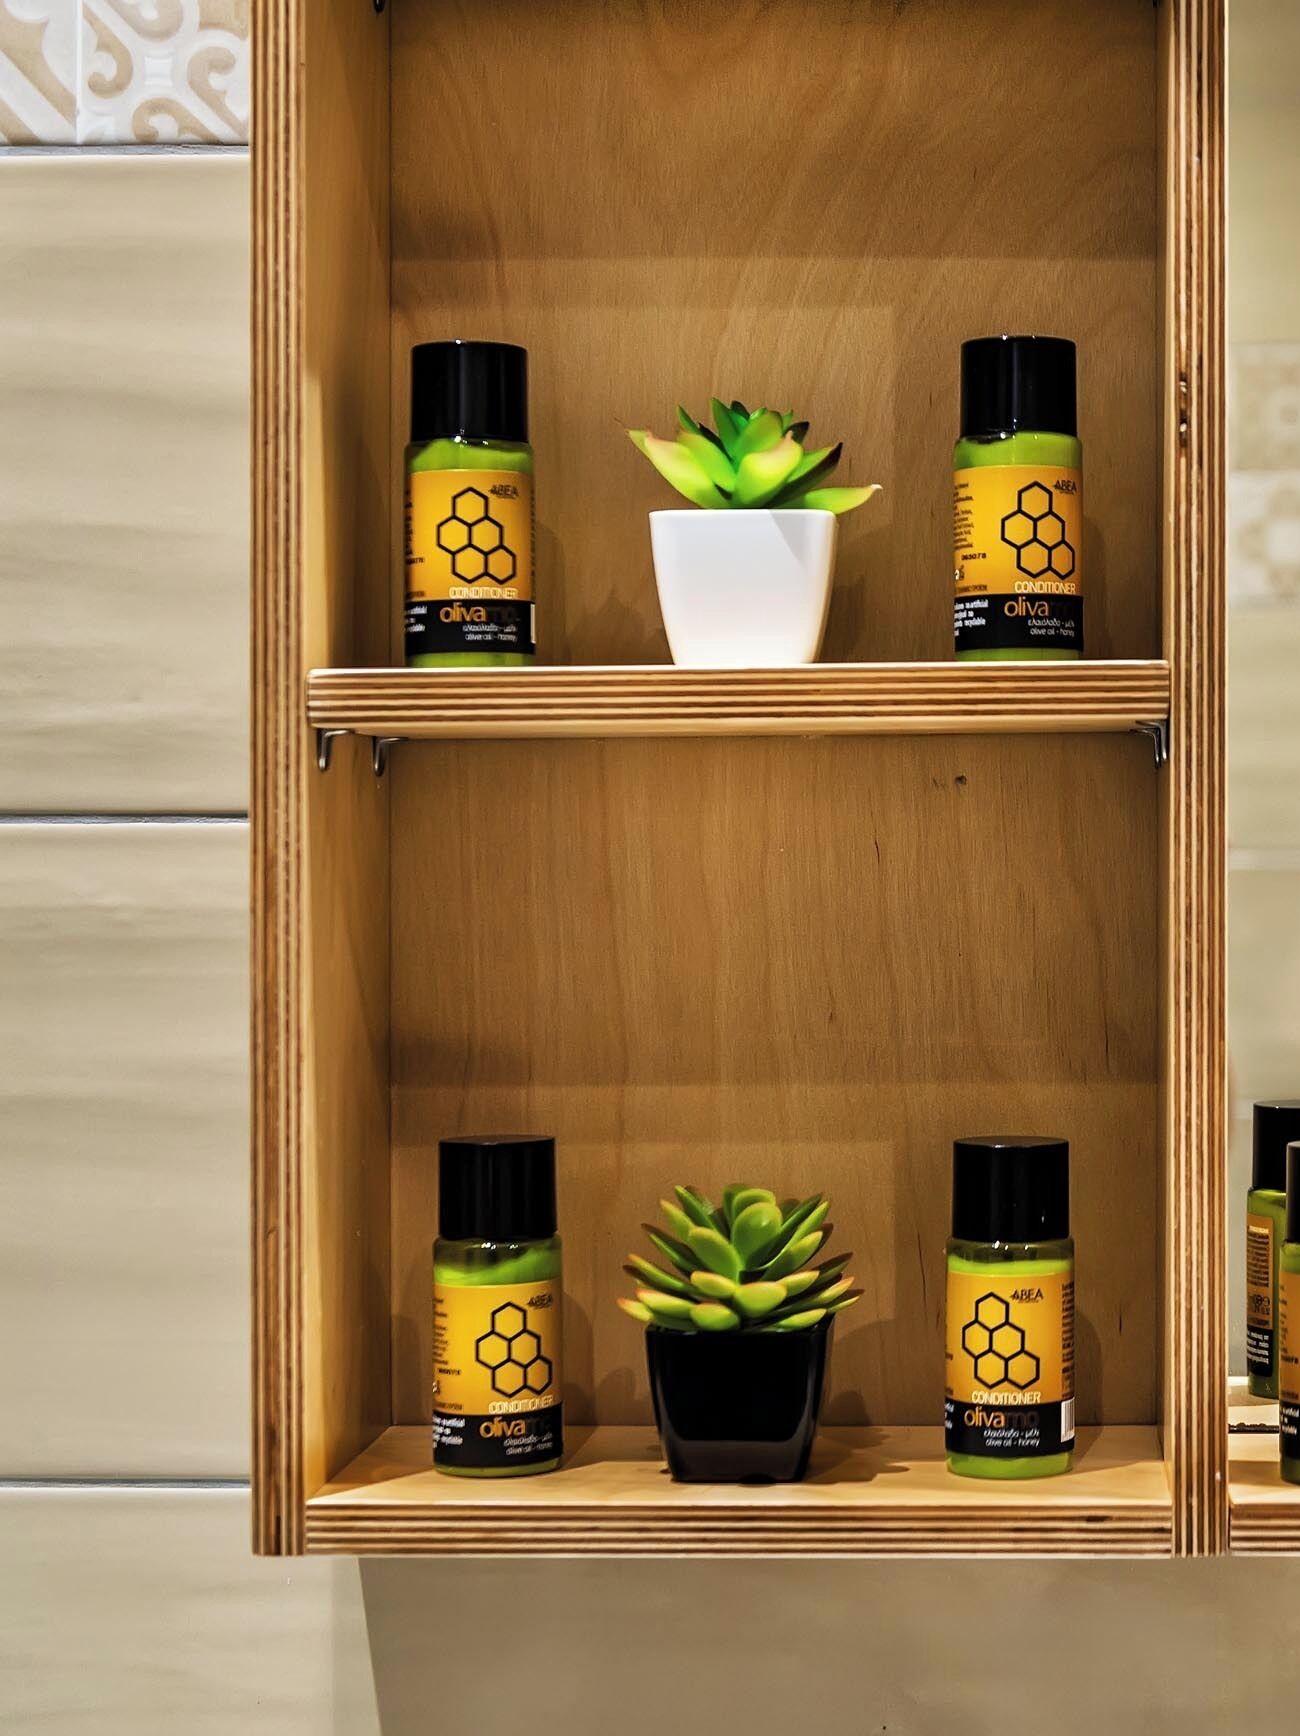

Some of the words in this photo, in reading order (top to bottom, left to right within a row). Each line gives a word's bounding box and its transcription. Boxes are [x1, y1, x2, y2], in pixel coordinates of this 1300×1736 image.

[449, 586, 518, 599] CONDITIONER
[1014, 581, 1076, 593] CONDITIONER
[972, 1391, 1041, 1404] CONDITIONER
